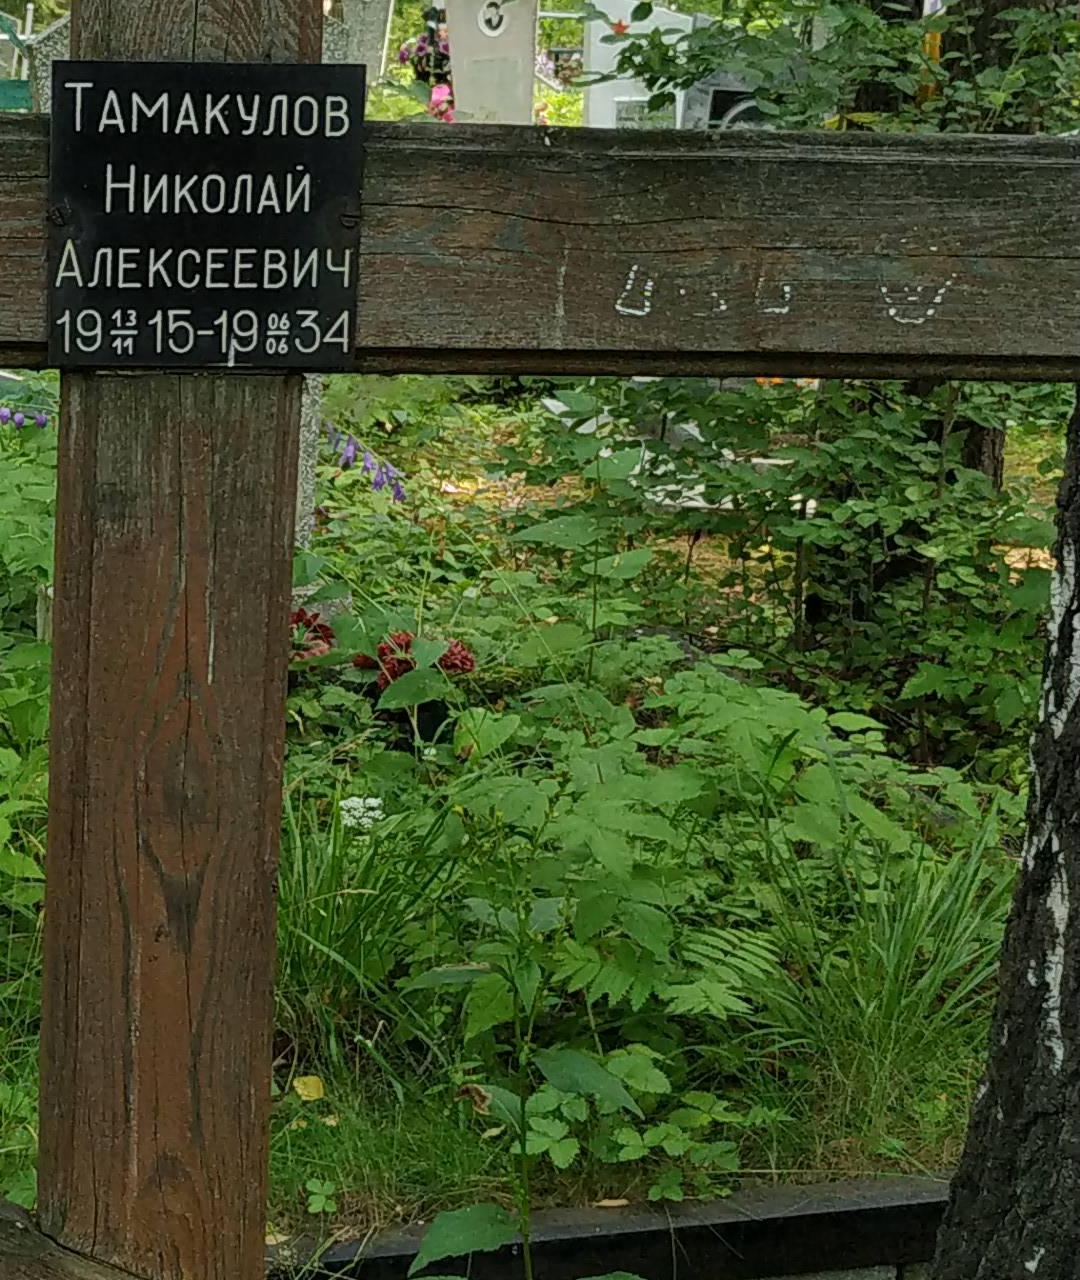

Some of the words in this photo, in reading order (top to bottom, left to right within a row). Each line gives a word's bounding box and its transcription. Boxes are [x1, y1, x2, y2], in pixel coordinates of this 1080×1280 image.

[65, 82, 350, 137] ТАМАКУЛОВ
[105, 164, 311, 214] НИКОЛАЙ
[55, 239, 351, 289] АЛЕКСЕЕВИЧ
